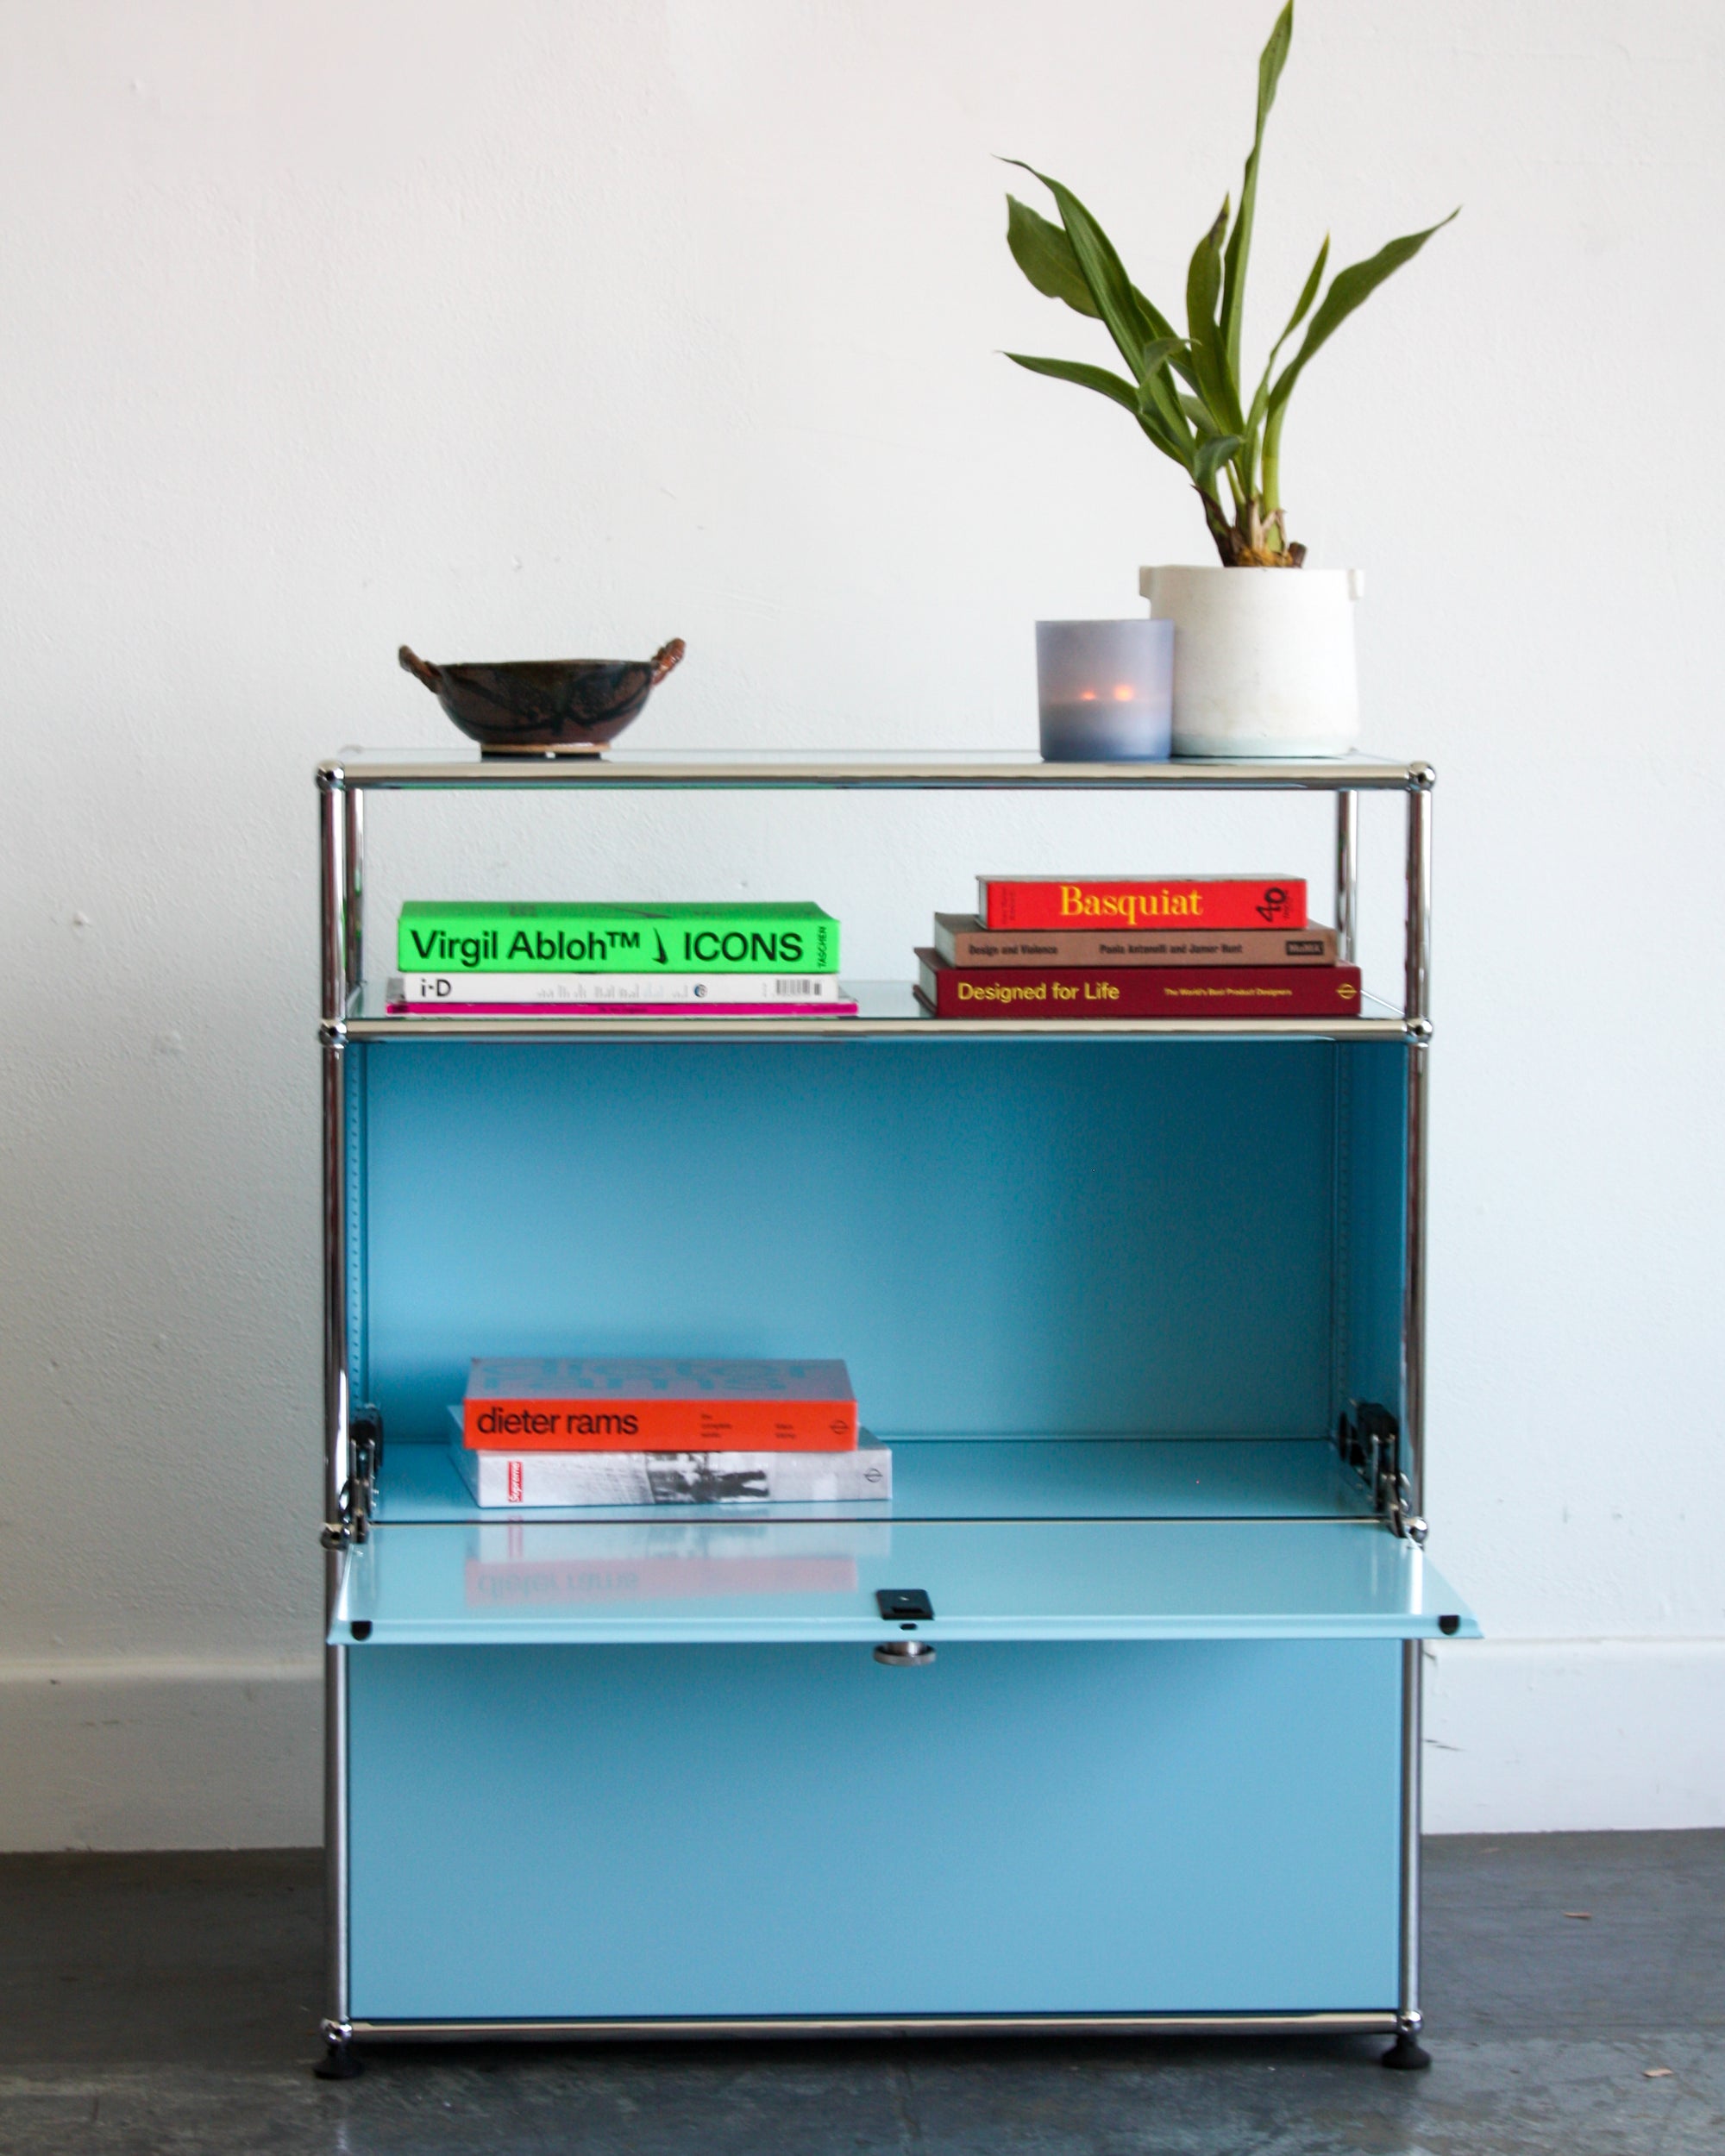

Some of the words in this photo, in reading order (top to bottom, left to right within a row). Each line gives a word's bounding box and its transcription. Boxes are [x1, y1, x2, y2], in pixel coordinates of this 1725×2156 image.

[1060, 885, 1204, 925] Basquiat
[1256, 887, 1287, 923] 40
[411, 929, 499, 967] Virgil
[685, 931, 804, 962] ICONS
[817, 925, 828, 968] TASCHEN
[957, 981, 1047, 1003] Designed
[1051, 981, 1080, 1000] for
[1084, 981, 1120, 1000] Life
[477, 1407, 561, 1434] dieter
[567, 1413, 640, 1435] rams
